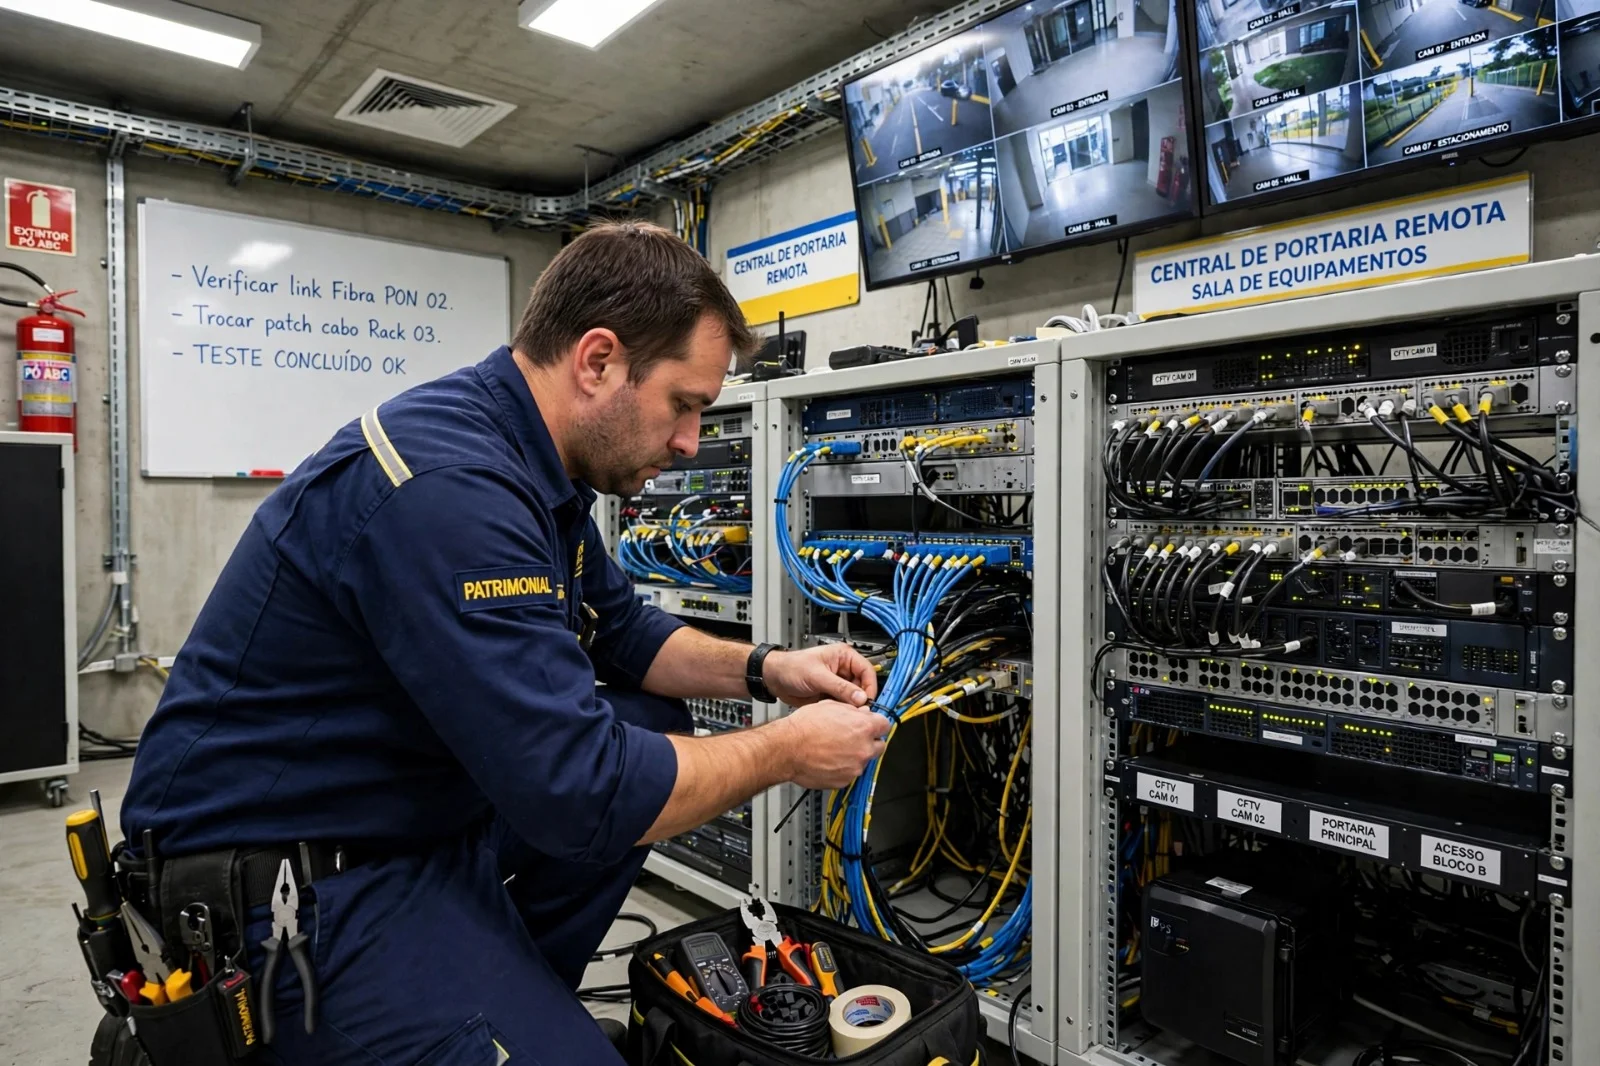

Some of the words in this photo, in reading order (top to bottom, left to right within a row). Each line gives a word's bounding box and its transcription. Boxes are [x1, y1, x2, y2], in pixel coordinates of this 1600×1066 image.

[1417, 48, 1434, 59] CAM
[1435, 45, 1445, 53] 07
[1450, 32, 1487, 50] ENTRADA
[1255, 97, 1270, 107] CAM
[1269, 95, 1278, 103] 05
[1283, 88, 1300, 99] HALL
[1052, 105, 1066, 116] CAM
[1404, 143, 1422, 154] CAM
[1422, 142, 1432, 151] 07
[1437, 123, 1509, 147] ESTACIONAMENTO
[1255, 181, 1271, 190] CAM
[1271, 178, 1280, 187] 05
[1284, 173, 1302, 183] HALL
[13, 226, 70, 242] EXTINTOR
[1068, 224, 1082, 234] CAM
[1095, 218, 1111, 228] HALL
[19, 234, 36, 247] PÓ
[37, 239, 62, 250] ABC
[1150, 252, 1236, 284] CENTRAL
[1241, 245, 1268, 267] DE
[1275, 223, 1388, 261] PORTARIA
[1395, 200, 1506, 240] REMOTA
[733, 251, 776, 275] CENTRAL
[778, 246, 791, 263] DE
[794, 231, 847, 258] PORTARIA
[766, 262, 808, 285] REMOTA
[1192, 278, 1234, 300] SALA
[1240, 273, 1263, 292] DE
[1269, 245, 1427, 288] EQUIPAMENTOS
[191, 264, 279, 296] Verificar
[290, 274, 322, 299] link
[332, 281, 375, 303] Fibra
[384, 285, 418, 307] PON
[426, 292, 453, 310] 02.
[192, 304, 254, 328] Trocar
[265, 312, 312, 337] patch
[321, 317, 359, 336] cabo
[368, 319, 406, 340] Rack
[413, 325, 441, 343] 03.
[192, 343, 262, 366] TESTE
[274, 349, 372, 373] CONCLUÍDO
[382, 356, 406, 375] OK
[24, 363, 42, 380] PÓ
[43, 366, 69, 381] ABC
[463, 576, 552, 600] PATRIMONIAL
[1155, 779, 1177, 792] CFTV
[1149, 790, 1168, 802] CAM
[1169, 795, 1179, 805] 01
[1236, 798, 1261, 811] CFTV
[1231, 808, 1252, 821] CAM
[1254, 814, 1265, 825] 02
[1322, 818, 1376, 838] PORTARIA
[1321, 829, 1376, 851] PRINCIPAL
[1434, 842, 1484, 862] ACESSO
[1433, 855, 1475, 875] BLOCO
[1478, 865, 1487, 877] B
